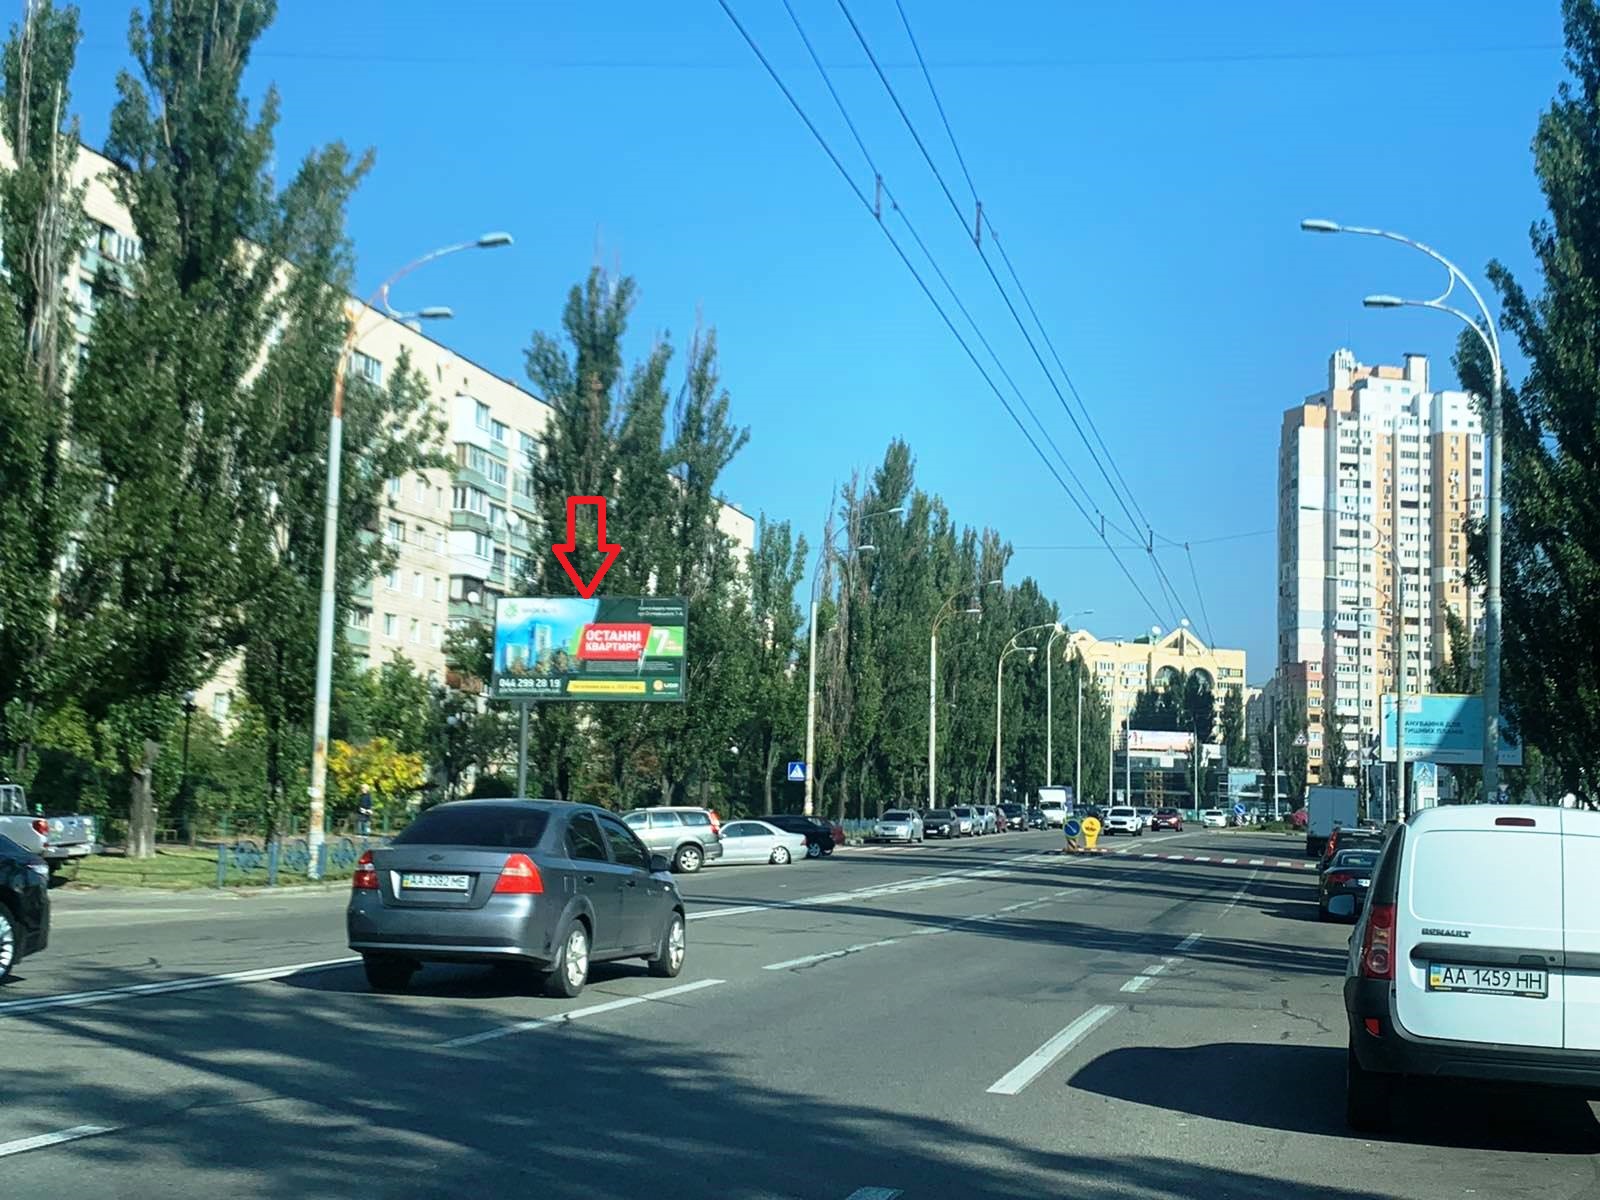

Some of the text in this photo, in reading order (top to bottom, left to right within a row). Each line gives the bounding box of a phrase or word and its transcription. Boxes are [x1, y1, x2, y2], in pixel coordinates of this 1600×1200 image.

[585, 629, 641, 641] ОСТАННІ
[585, 641, 643, 652] КВАРТИРИ
[653, 628, 670, 656] 7
[499, 679, 516, 688] 044
[517, 679, 535, 688] 299
[549, 679, 561, 688] 19
[1442, 967, 1542, 989] AA 1459 HH
